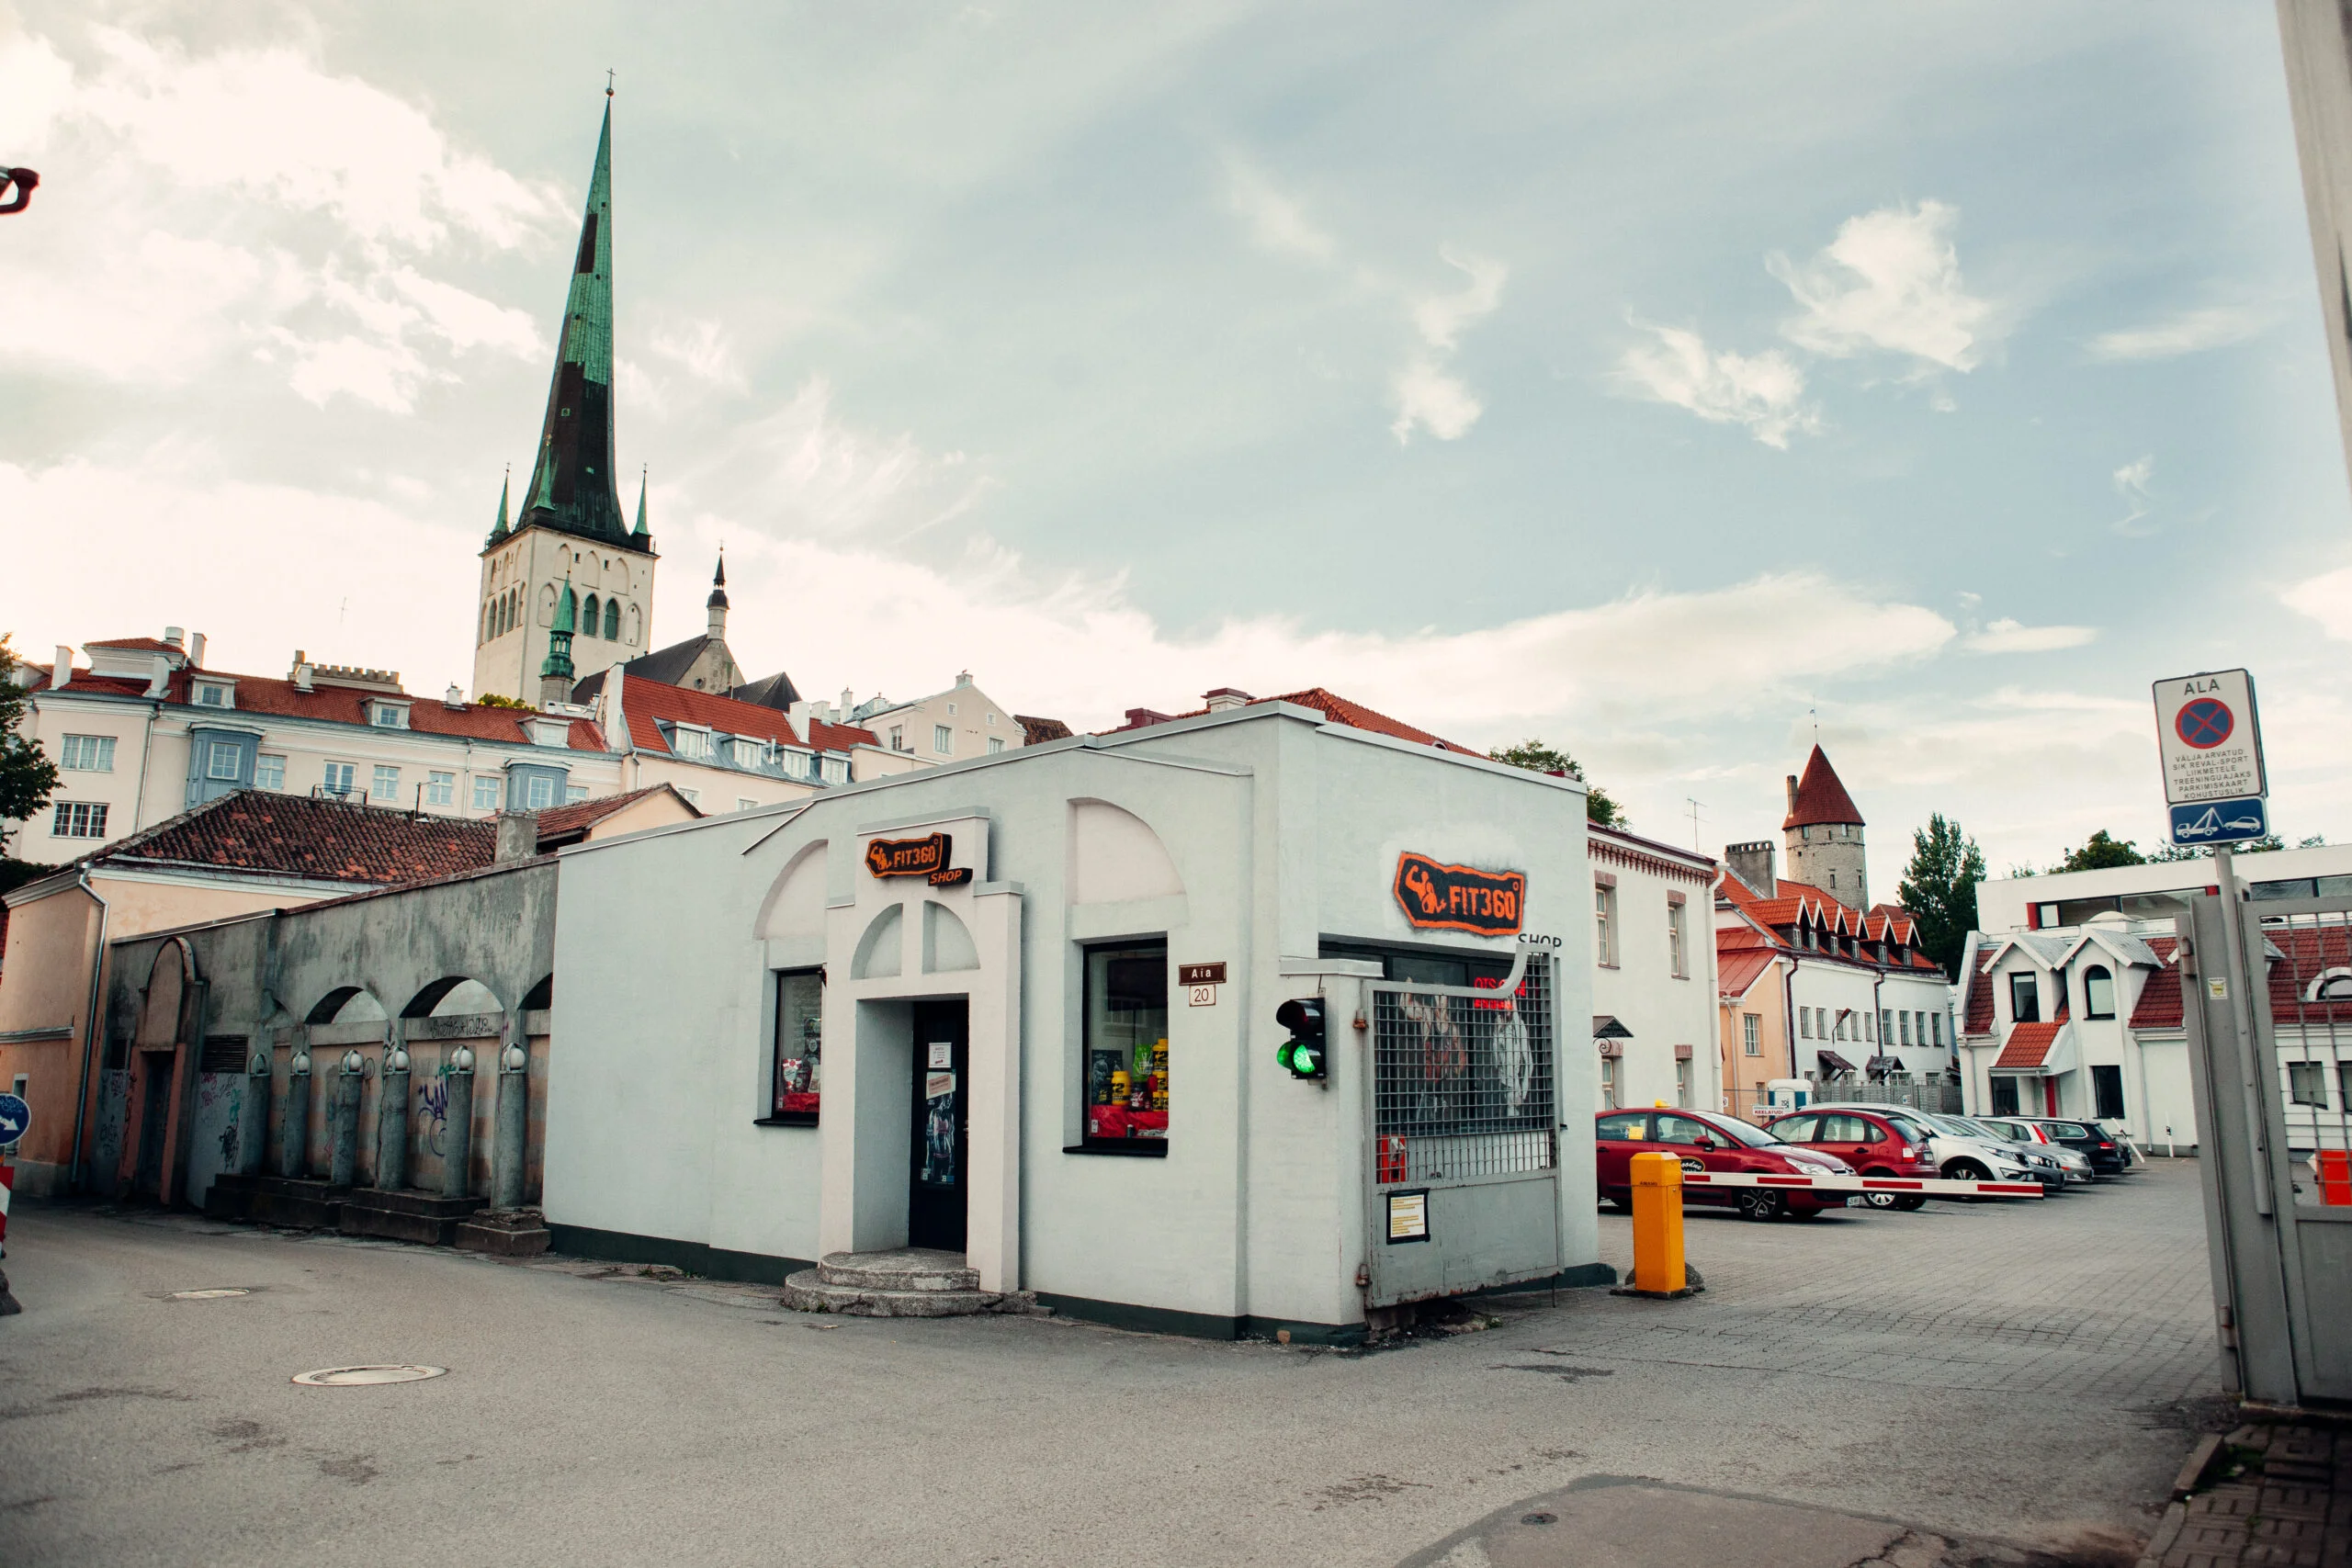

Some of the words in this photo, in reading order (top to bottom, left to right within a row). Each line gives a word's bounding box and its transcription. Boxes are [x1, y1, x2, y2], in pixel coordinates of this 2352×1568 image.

[2184, 678, 2221, 695] ALA
[2205, 749, 2244, 759] ARVATUD
[2189, 756, 2248, 768] REVAL-SPORT
[2186, 765, 2236, 776] LIIKMETELE
[2178, 779, 2247, 792] PARKIMISKAART
[2185, 787, 2245, 799] KOHUSTUSLIK
[929, 870, 963, 884] SHOP
[1192, 968, 1211, 978] Aia
[1194, 988, 1209, 1002] 20
